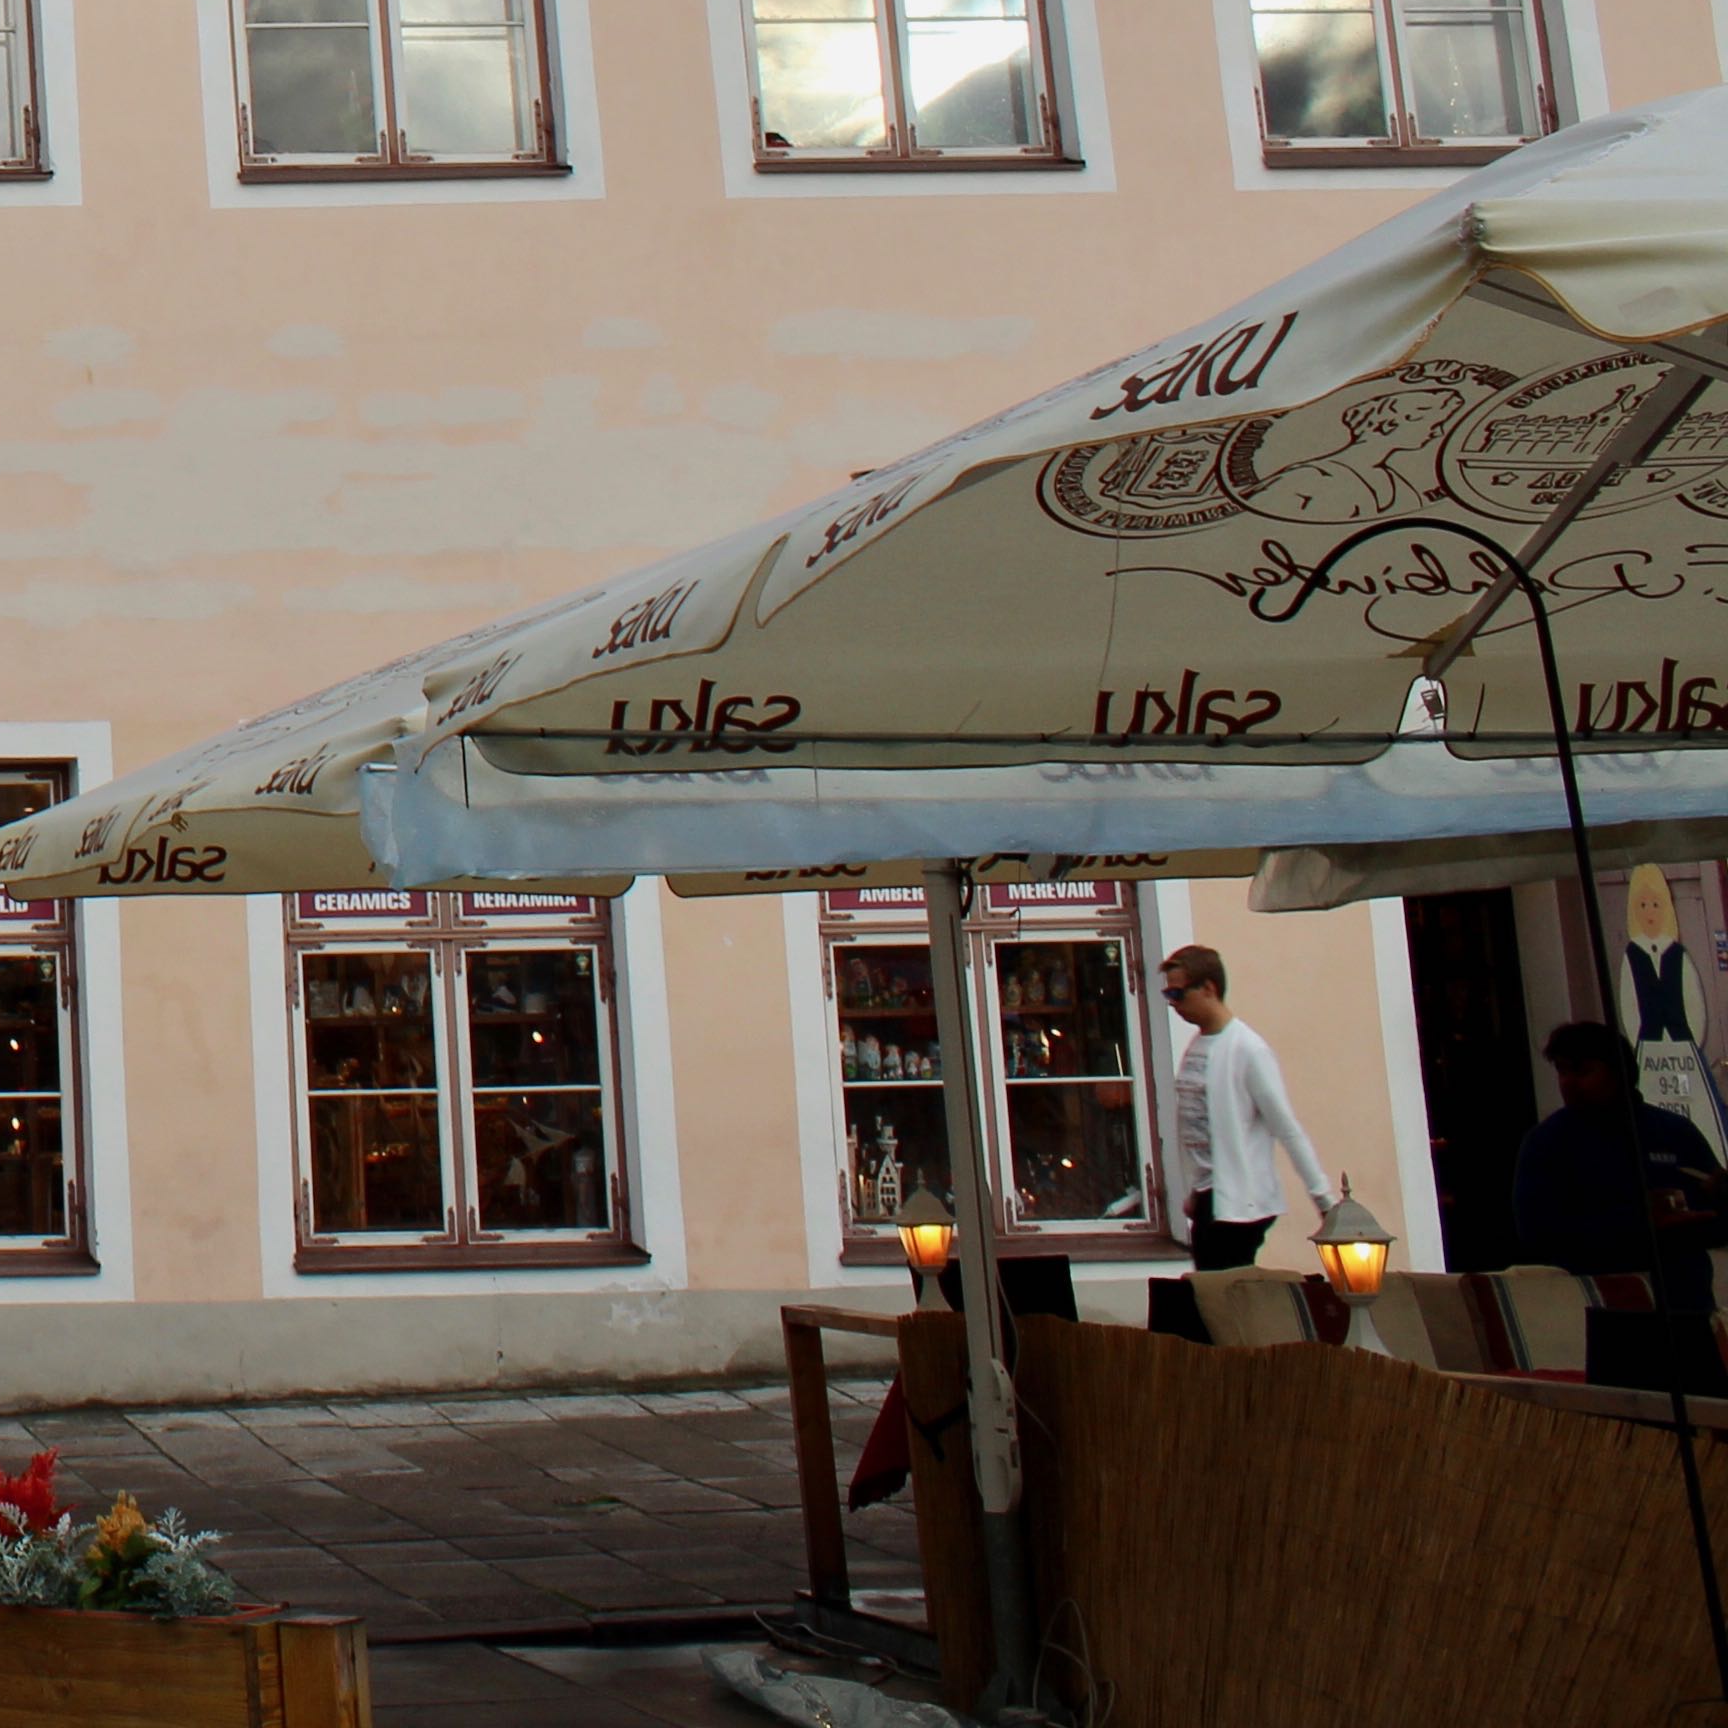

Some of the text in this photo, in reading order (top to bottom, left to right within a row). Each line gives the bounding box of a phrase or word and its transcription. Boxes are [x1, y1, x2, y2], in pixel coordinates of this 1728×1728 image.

[1089, 311, 1299, 420] saku
[592, 578, 701, 660] saku
[313, 891, 412, 912] CERAMICS
[1644, 1055, 1695, 1072] AVATUD
